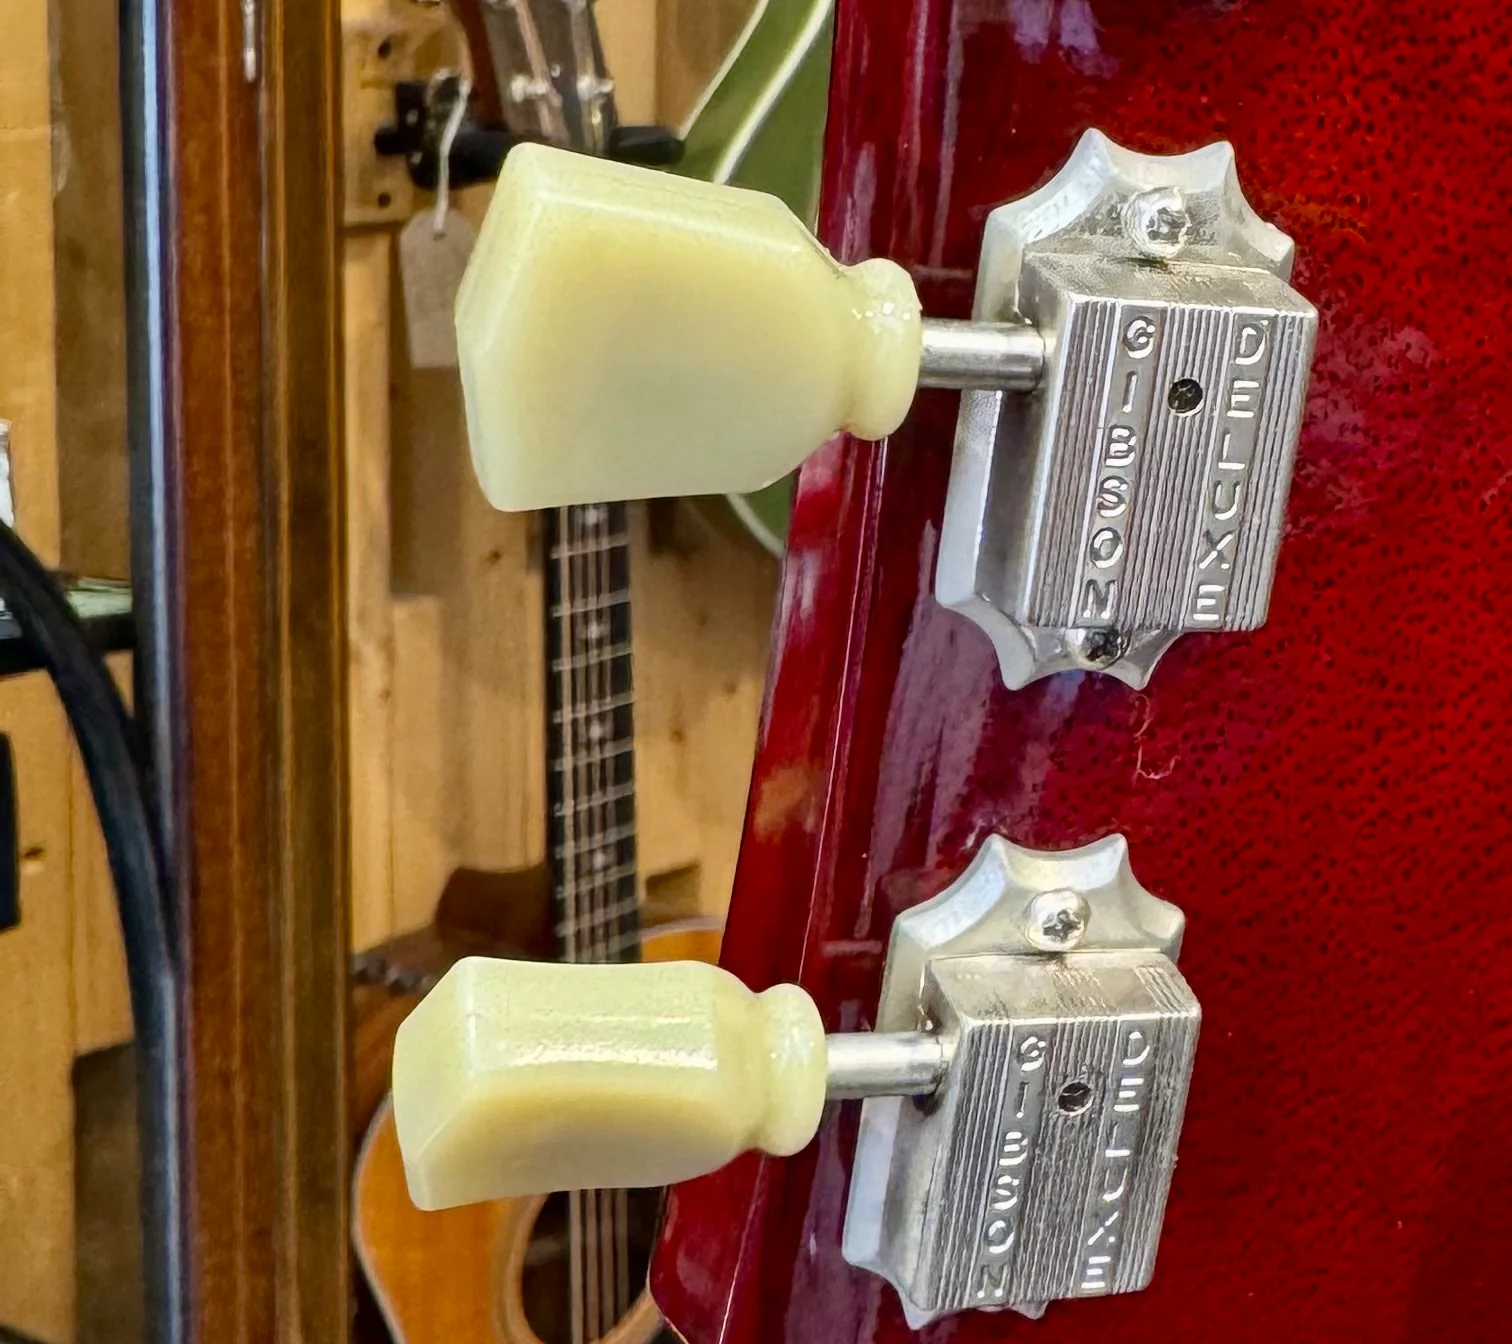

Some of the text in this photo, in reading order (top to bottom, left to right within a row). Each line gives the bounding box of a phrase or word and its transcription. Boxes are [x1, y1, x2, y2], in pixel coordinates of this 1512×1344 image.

[1081, 315, 1157, 620] GIBSON
[1192, 319, 1268, 622] DELUXE
[976, 1035, 1047, 1299] GIBSON
[1080, 1031, 1151, 1290] DELUXE
